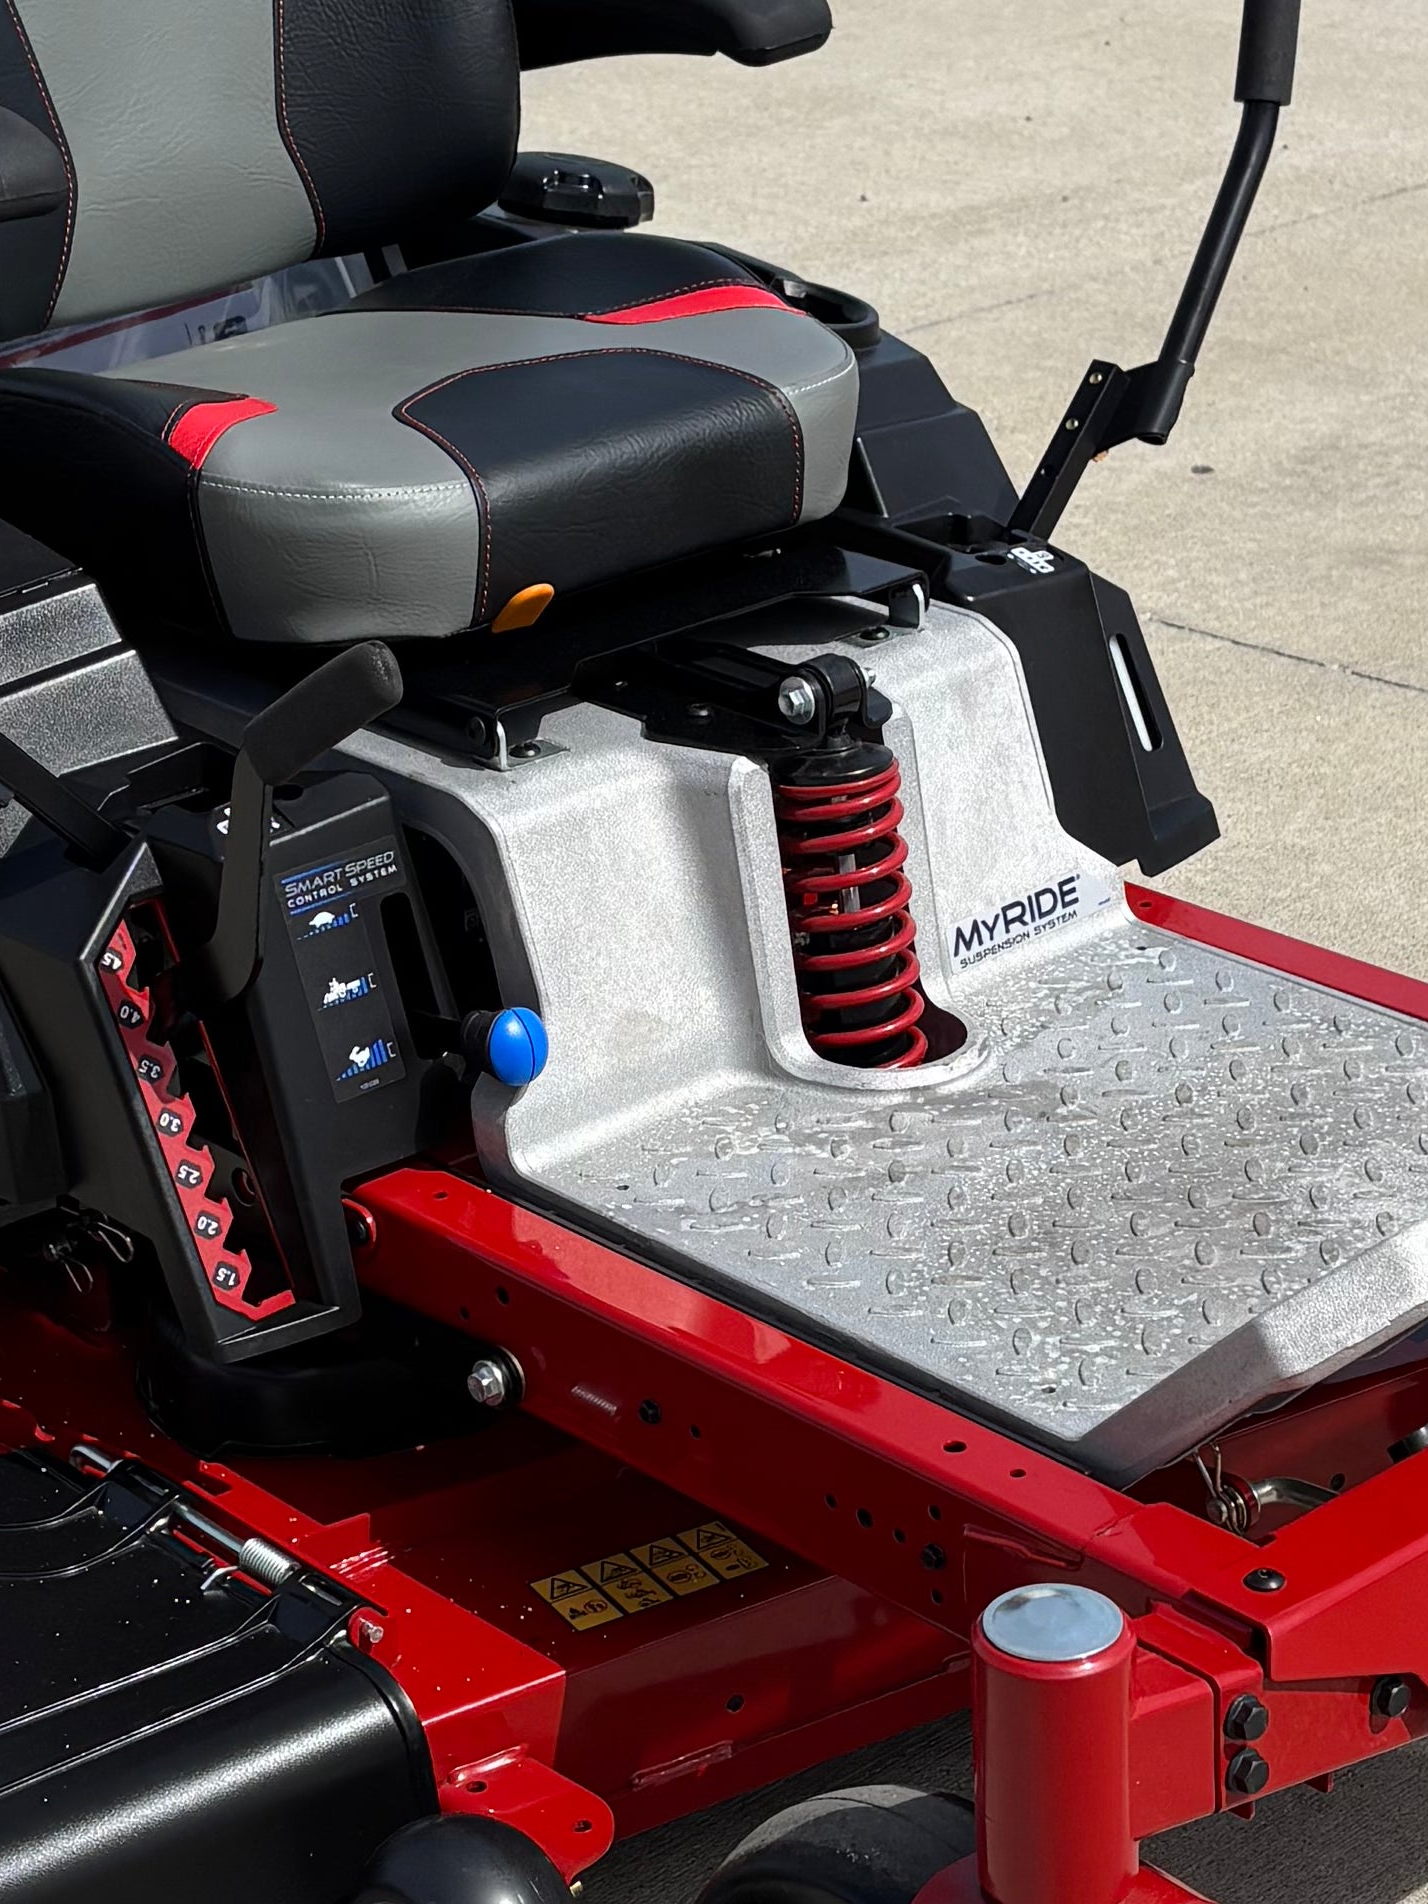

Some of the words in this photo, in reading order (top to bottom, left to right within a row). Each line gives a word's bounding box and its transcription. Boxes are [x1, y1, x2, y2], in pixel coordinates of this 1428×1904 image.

[287, 884, 344, 908] CONTROL
[349, 864, 398, 887] SYSTEM
[960, 930, 1031, 968] SUSPENSION
[1034, 909, 1078, 935] SYSTEM
[119, 1005, 141, 1024] 4.0
[139, 1059, 161, 1079] 3.5
[159, 1112, 181, 1132] 3.0
[178, 1165, 201, 1184] 2.5
[197, 1216, 219, 1235] 2.0
[216, 1267, 237, 1286] 1.5
